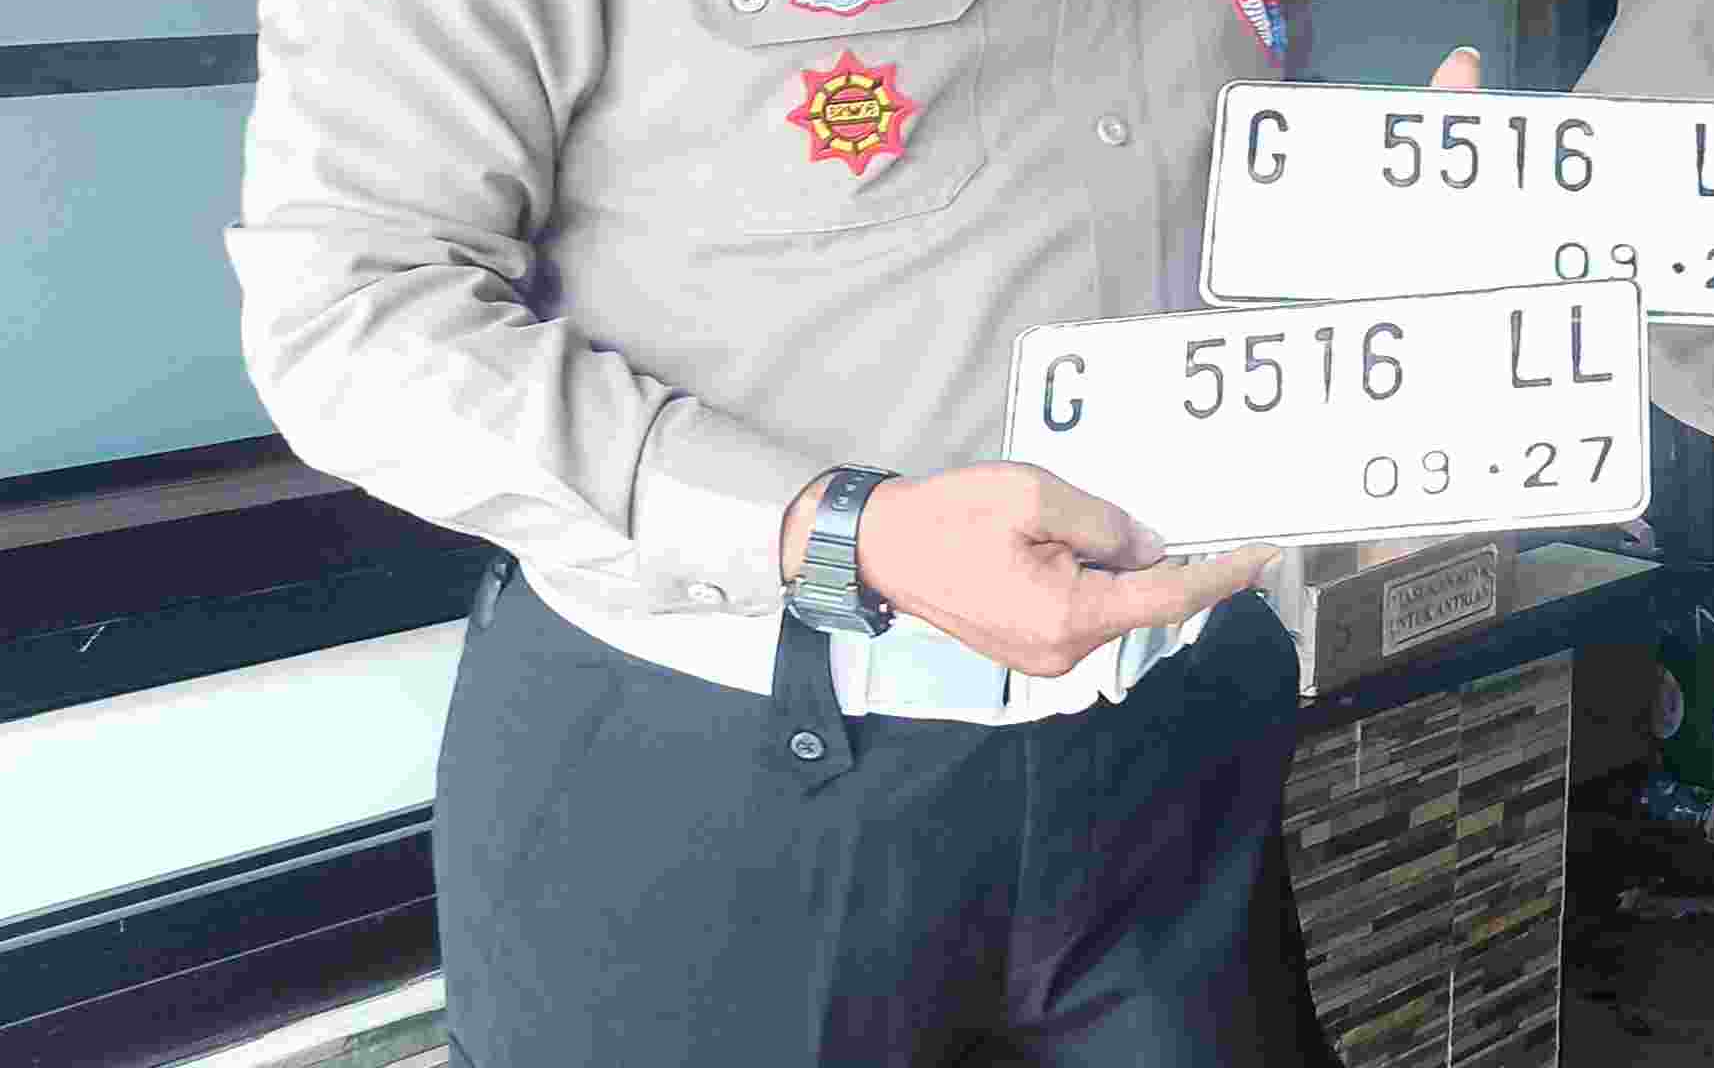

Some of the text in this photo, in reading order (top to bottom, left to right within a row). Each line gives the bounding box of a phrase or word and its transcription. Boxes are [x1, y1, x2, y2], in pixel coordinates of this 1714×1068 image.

[1247, 109, 1289, 184] G
[1382, 113, 1595, 193] 5516
[1042, 304, 1614, 432] G 5516 LL
